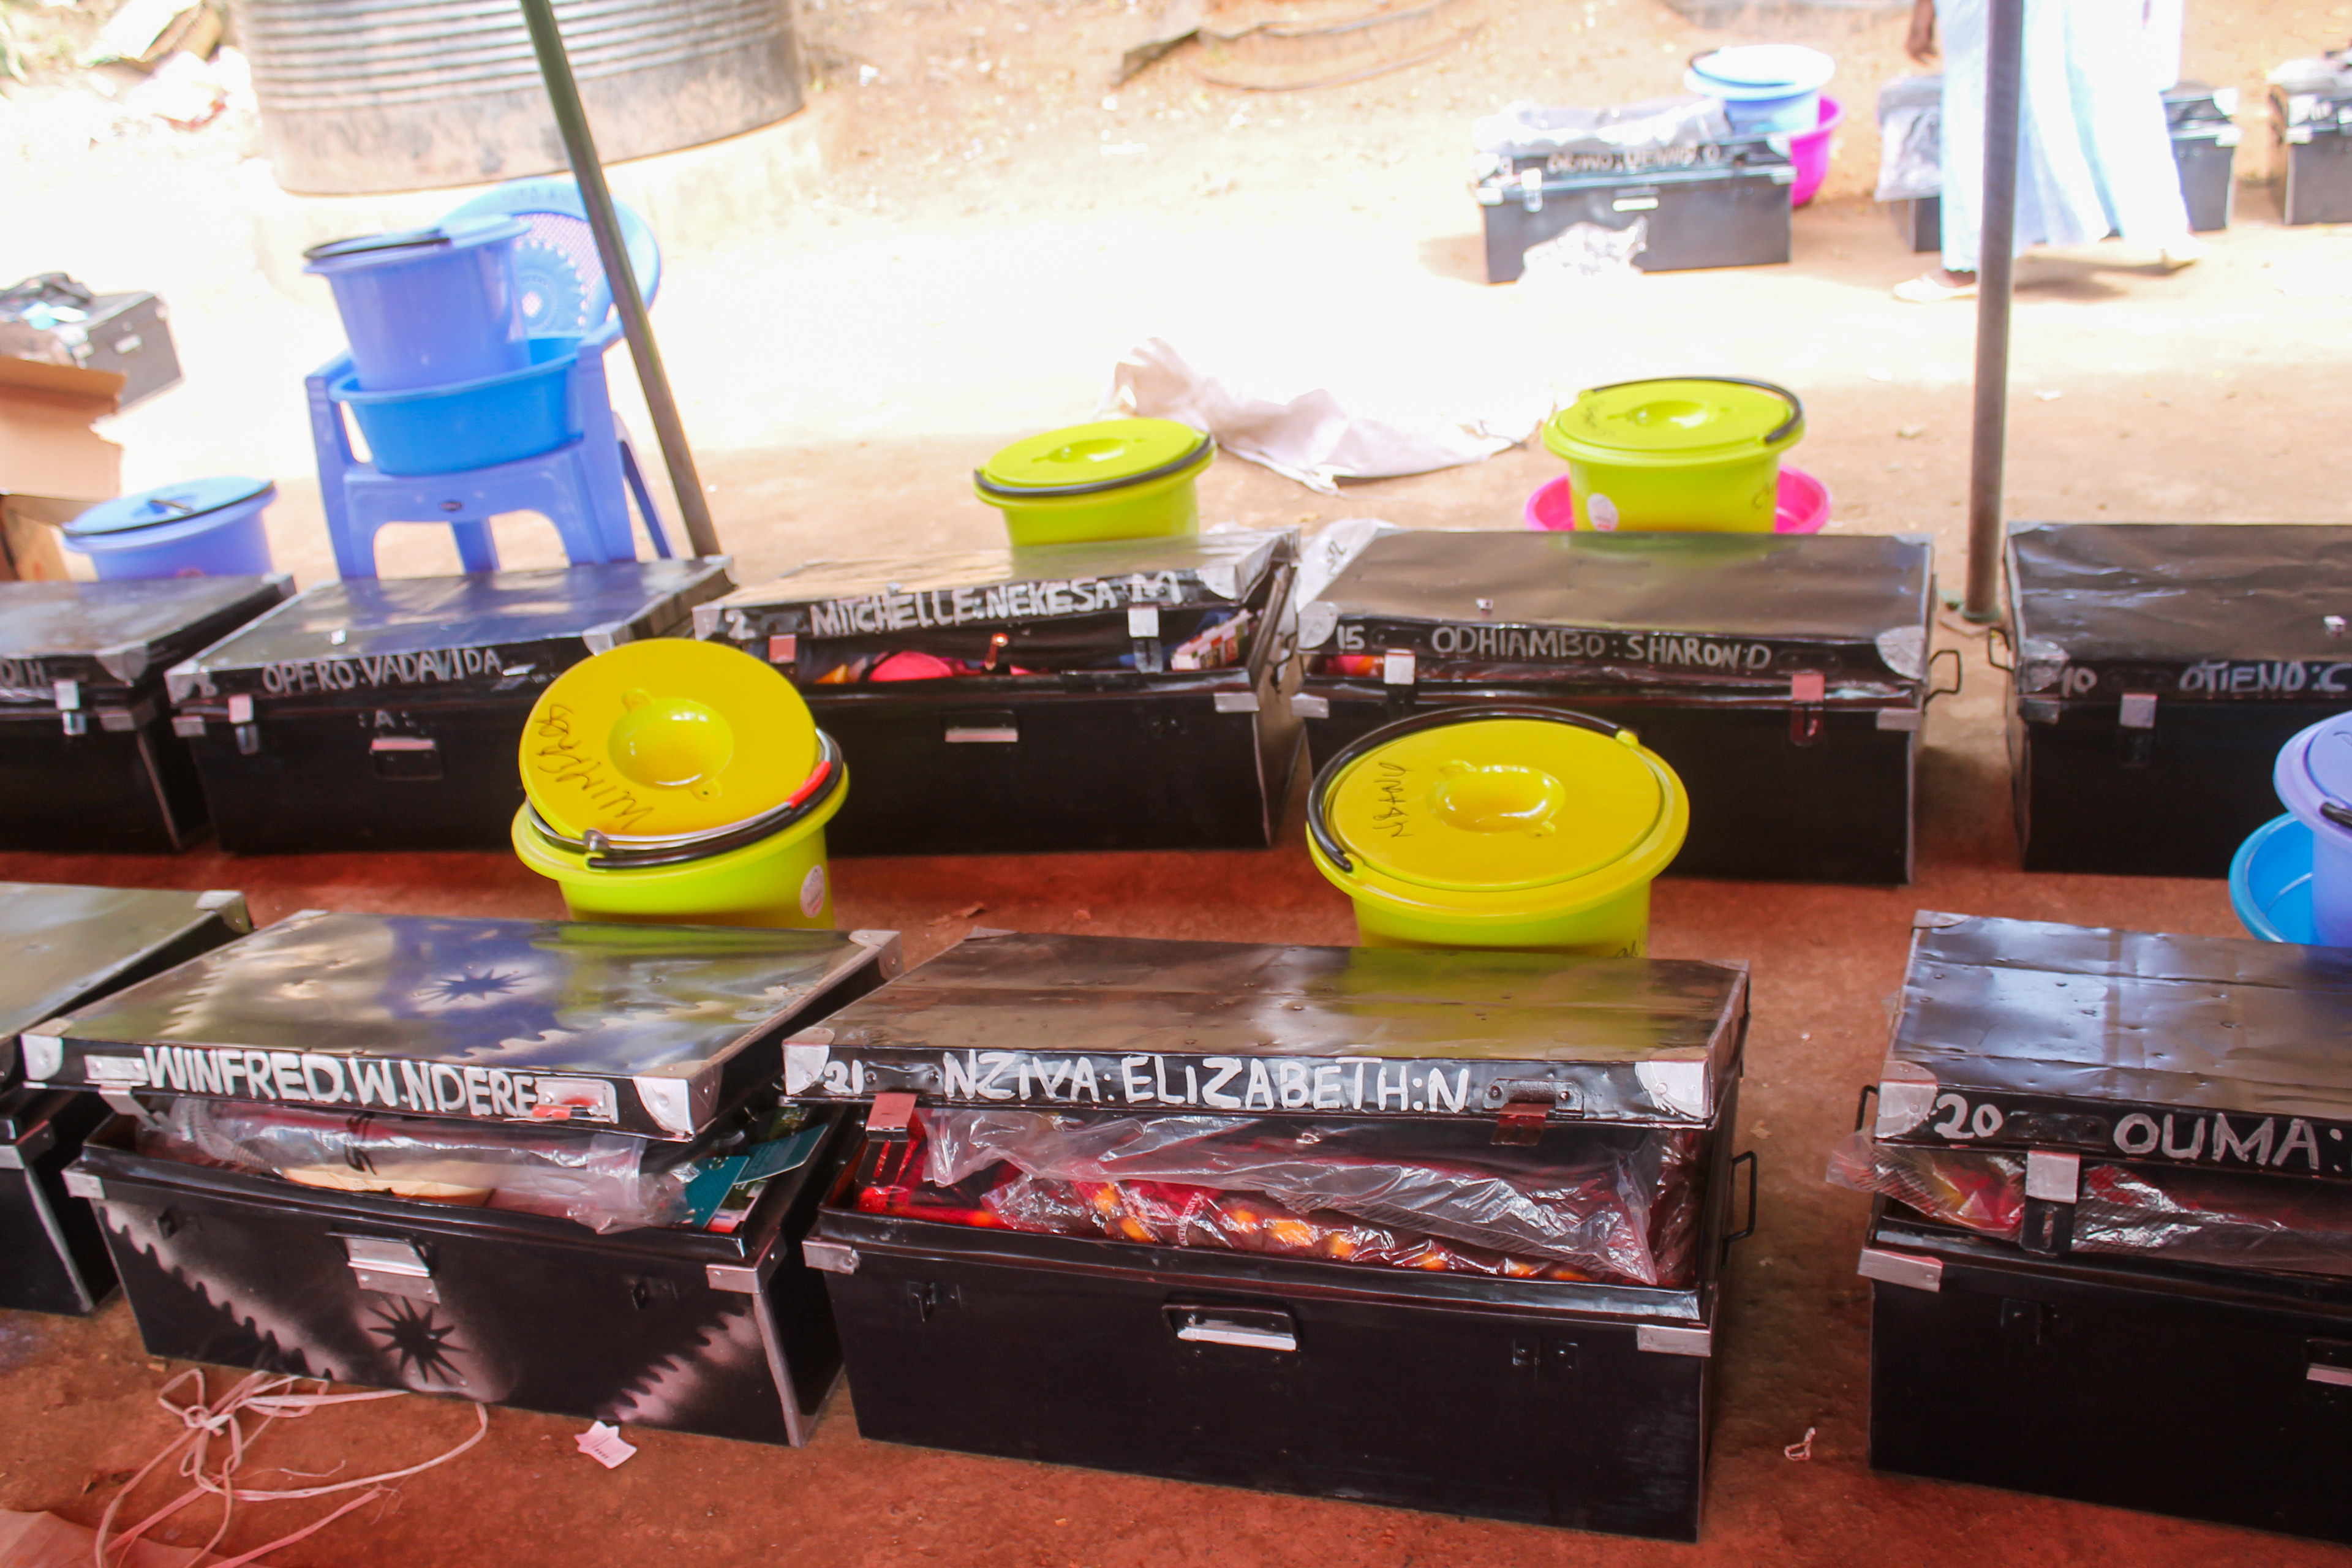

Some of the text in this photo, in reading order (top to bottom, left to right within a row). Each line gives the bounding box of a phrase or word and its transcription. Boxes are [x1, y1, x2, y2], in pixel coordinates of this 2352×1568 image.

[1335, 624, 1365, 650] 15
[823, 1059, 864, 1096] 21
[1933, 1093, 2005, 1139] 20
